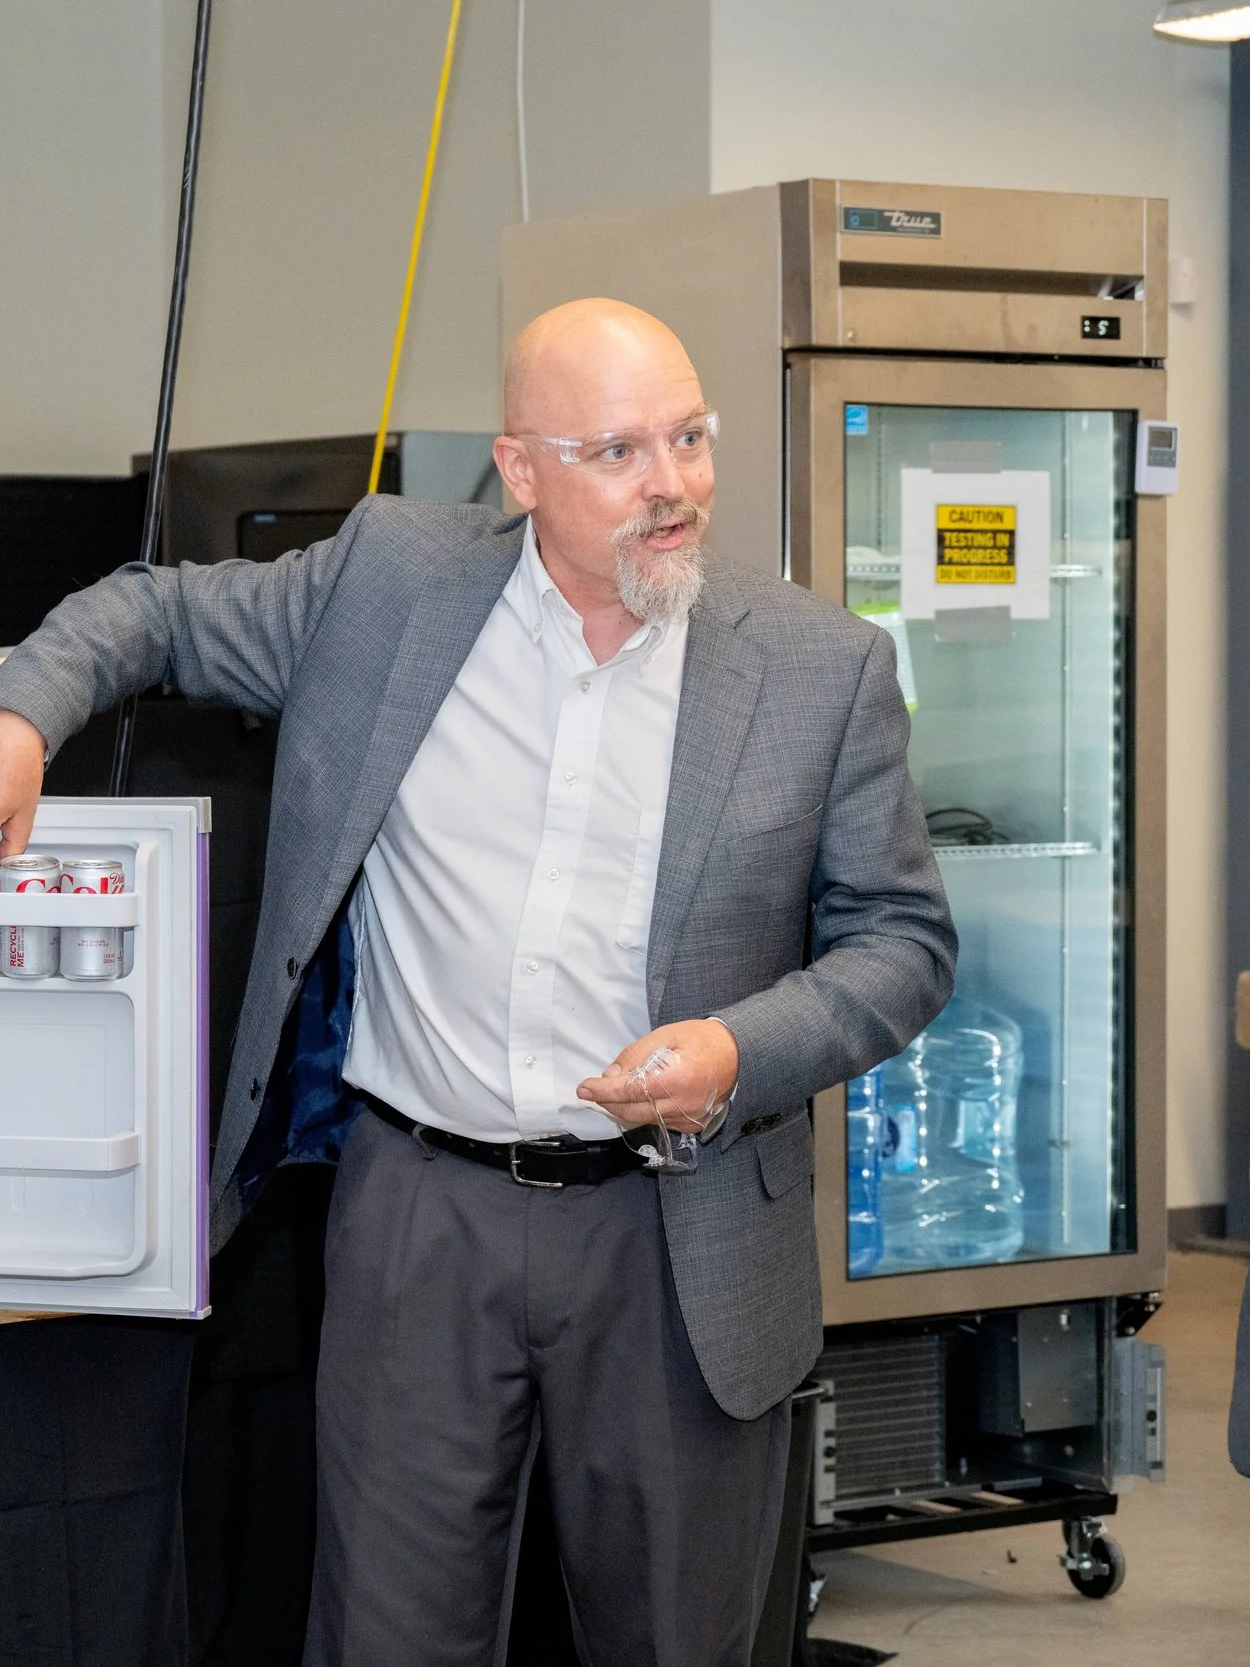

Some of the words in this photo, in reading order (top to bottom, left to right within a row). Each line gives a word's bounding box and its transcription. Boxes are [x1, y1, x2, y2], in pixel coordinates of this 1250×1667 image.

[883, 210, 937, 229] True
[948, 509, 1005, 524] CAUTION
[943, 531, 994, 548] TESTING
[995, 532, 1010, 548] IN
[943, 548, 1009, 564] PROGRESS
[9, 925, 17, 967] RECYCL
[16, 953, 25, 968] ME
